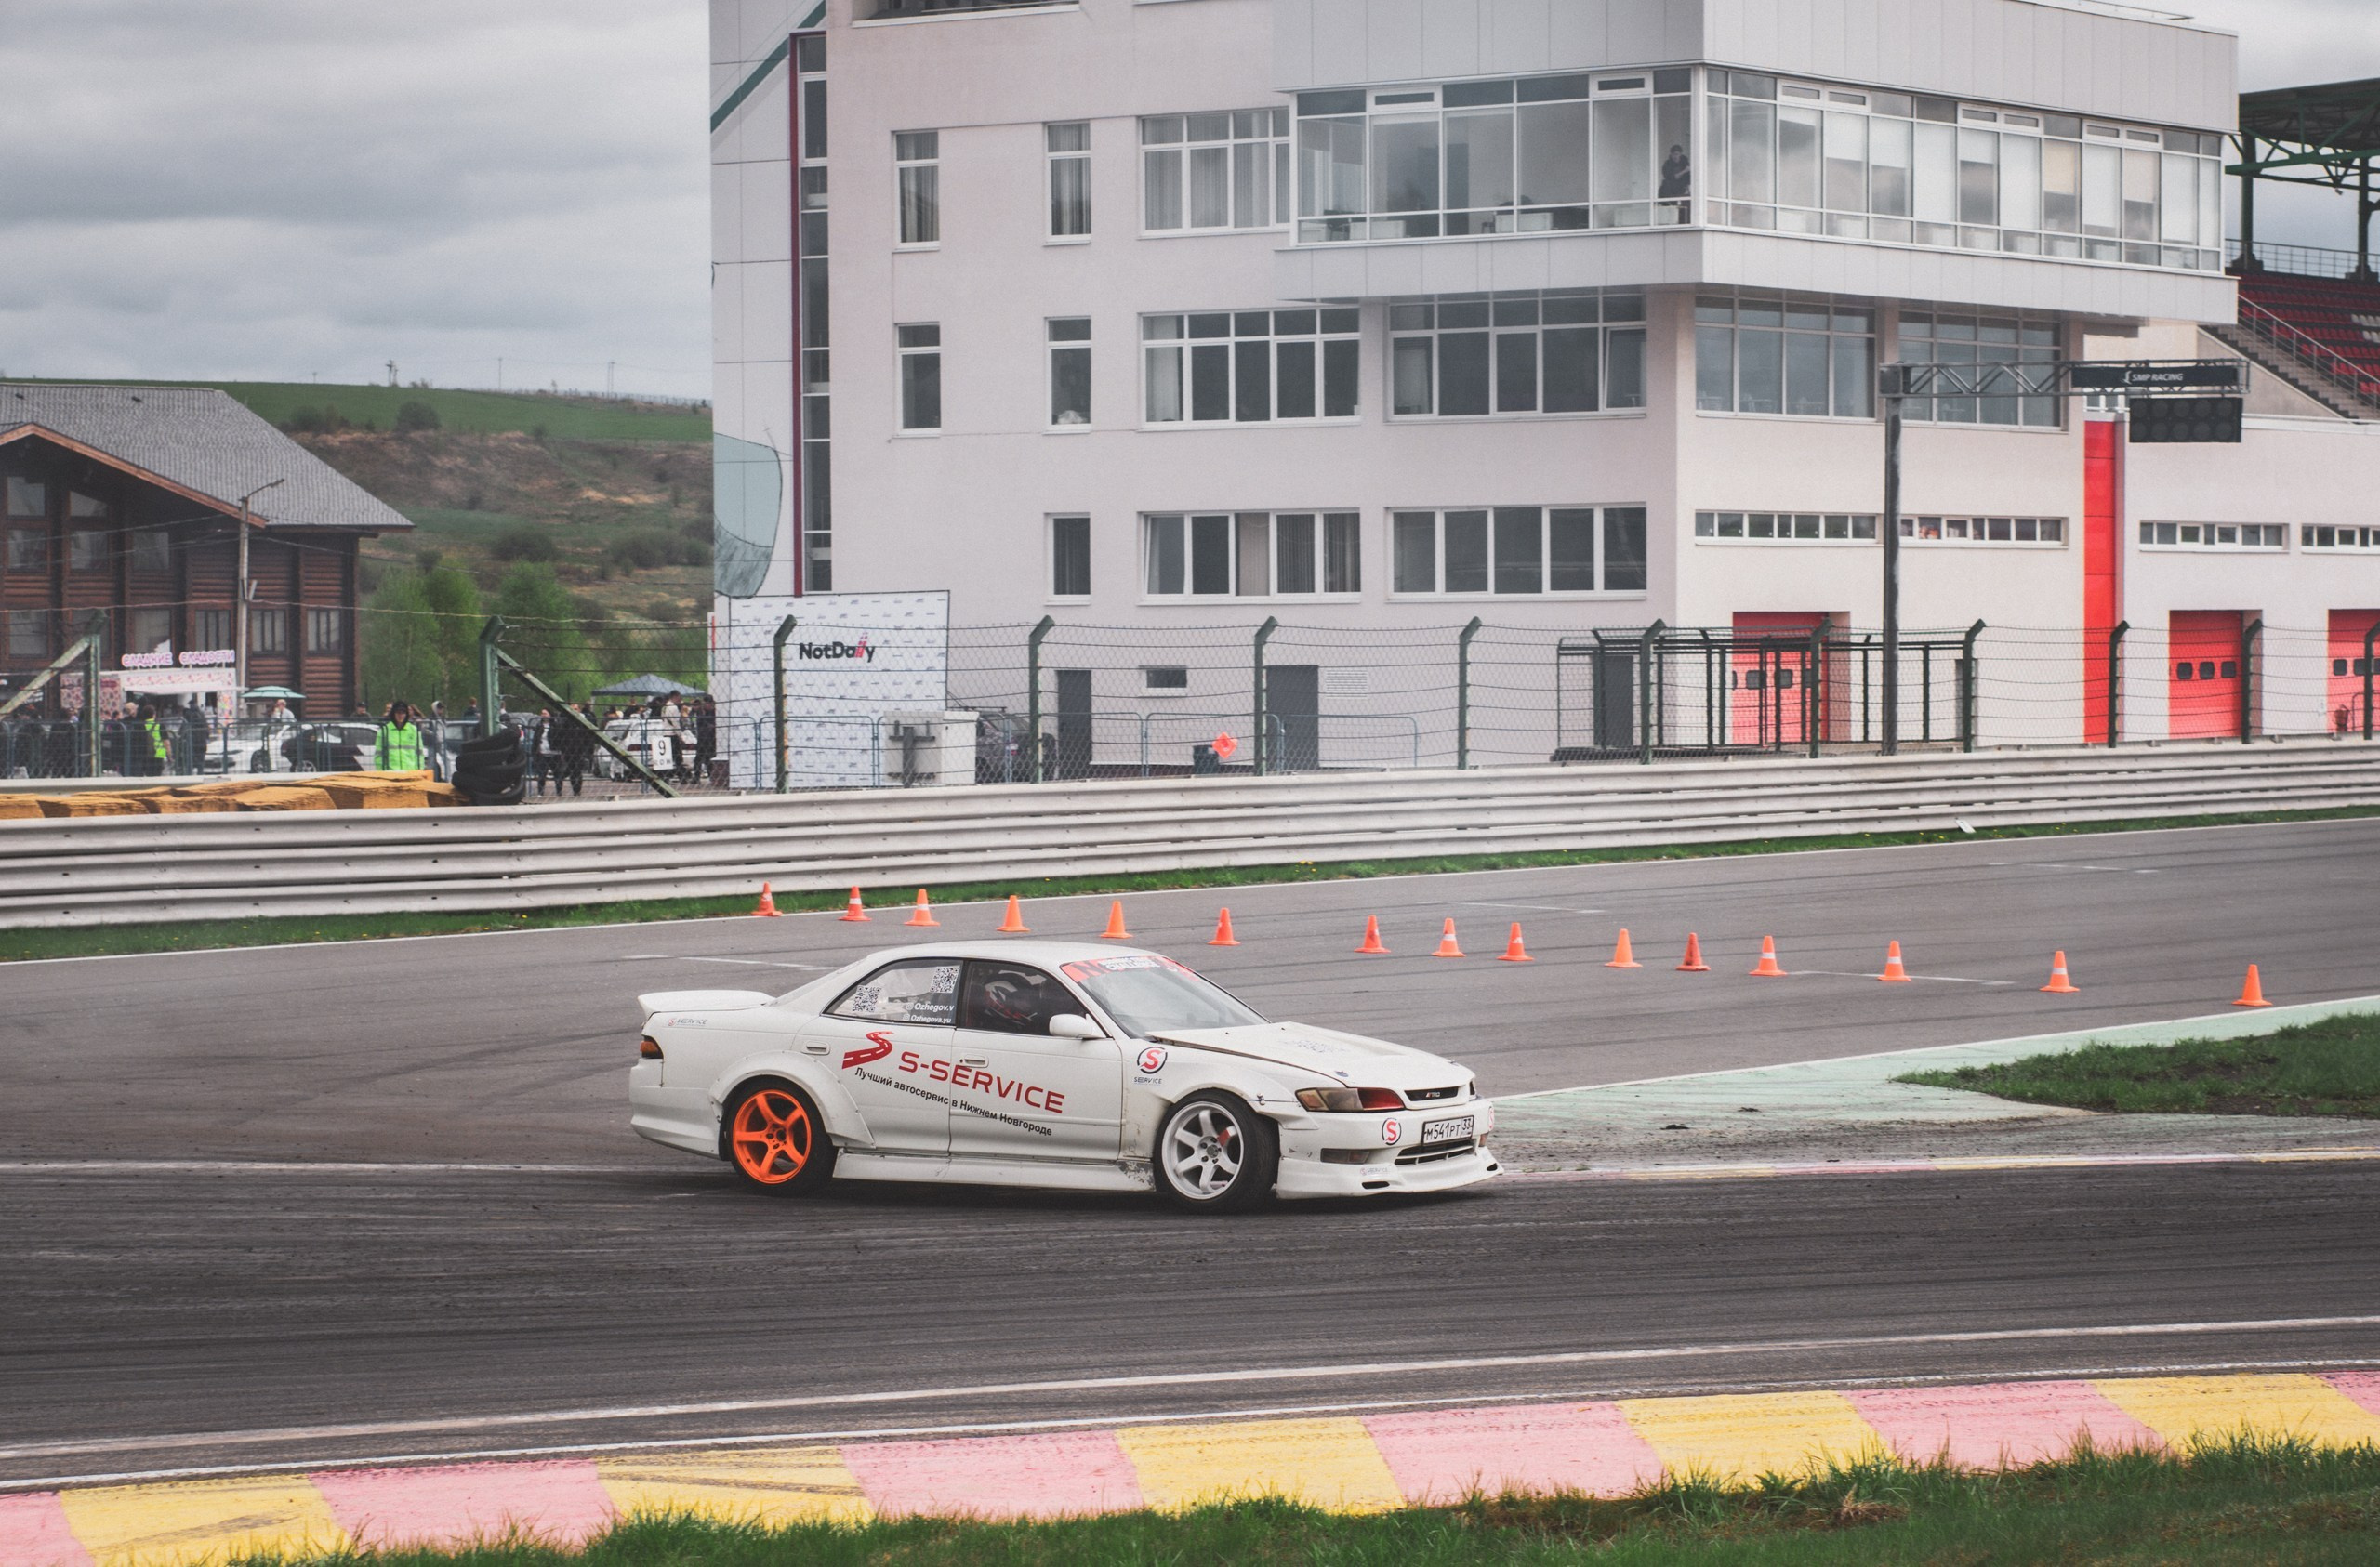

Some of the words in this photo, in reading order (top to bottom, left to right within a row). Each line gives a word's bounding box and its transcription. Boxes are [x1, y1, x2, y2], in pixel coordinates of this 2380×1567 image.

[2132, 373, 2150, 382] SMP
[2151, 373, 2184, 381] RACING
[800, 633, 876, 663] NotDaily
[658, 740, 667, 756] 9
[914, 1002, 955, 1011] Ozhegov.v
[898, 1050, 1065, 1114] S-SERVICE
[854, 1067, 892, 1086] Лучший
[893, 1081, 949, 1105] автосервис
[951, 1100, 959, 1108] в
[959, 1100, 998, 1120] Нижнем
[999, 1113, 1052, 1136] Новгороде
